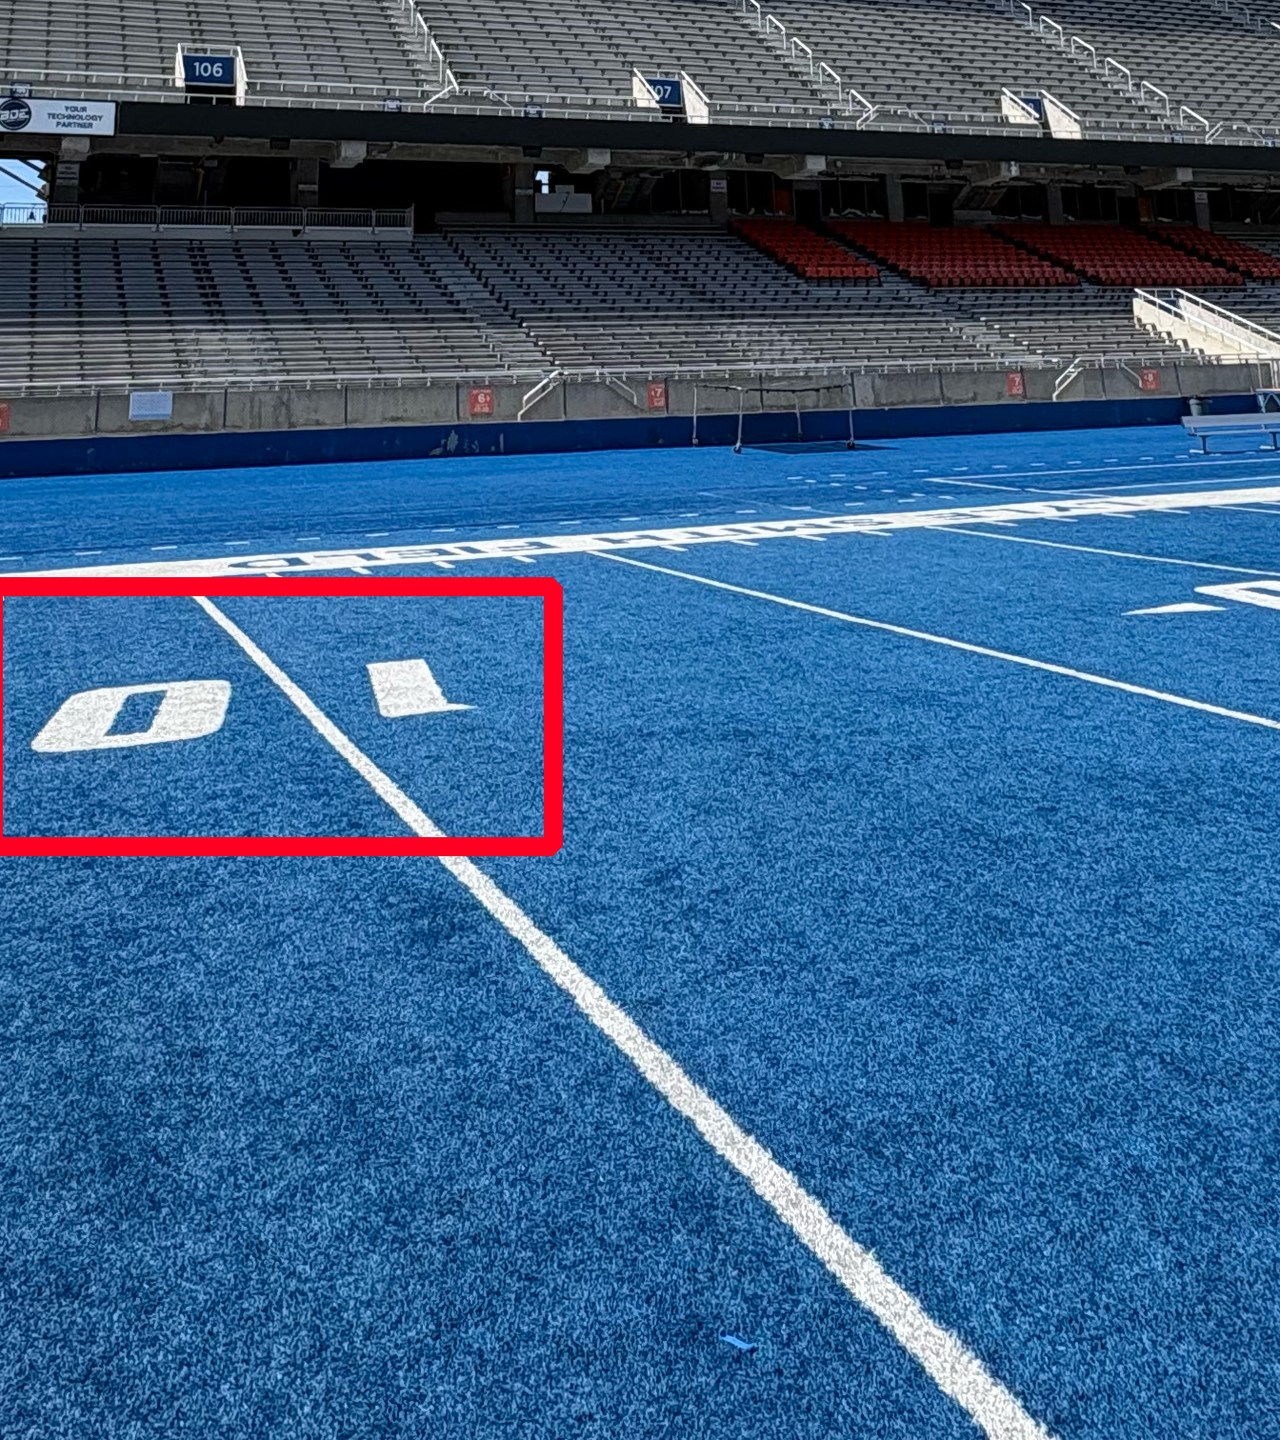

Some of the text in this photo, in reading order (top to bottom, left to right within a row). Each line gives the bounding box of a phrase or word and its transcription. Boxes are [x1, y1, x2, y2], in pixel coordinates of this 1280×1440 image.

[193, 61, 223, 77] 106
[651, 84, 672, 99] 07
[64, 105, 87, 113] YOUR
[47, 112, 104, 122] TECHNOLOGY
[56, 121, 93, 129] PARTNER
[477, 393, 486, 404] 6
[228, 541, 558, 569] FIELD
